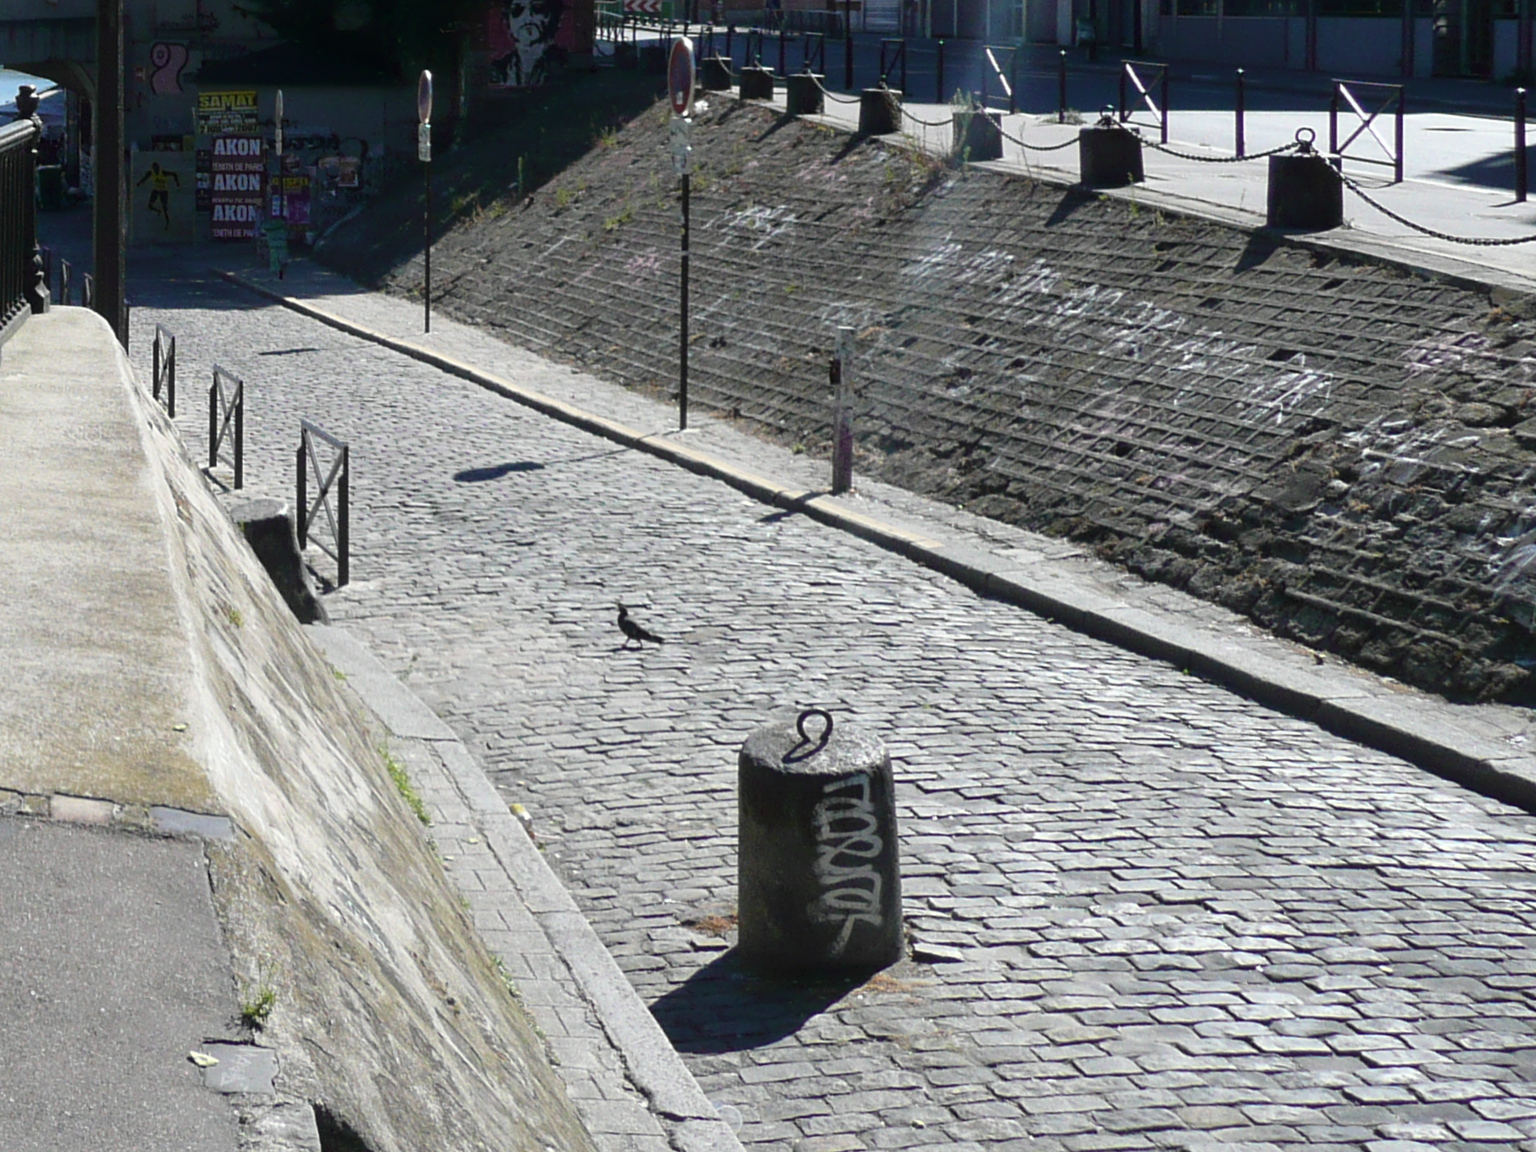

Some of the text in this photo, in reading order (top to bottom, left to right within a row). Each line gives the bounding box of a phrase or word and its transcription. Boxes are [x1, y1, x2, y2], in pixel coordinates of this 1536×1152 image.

[237, 124, 258, 133] 2007
[213, 138, 261, 156] AKON
[234, 162, 243, 171] DE
[244, 162, 264, 172] PARIS
[213, 173, 261, 191] AKON
